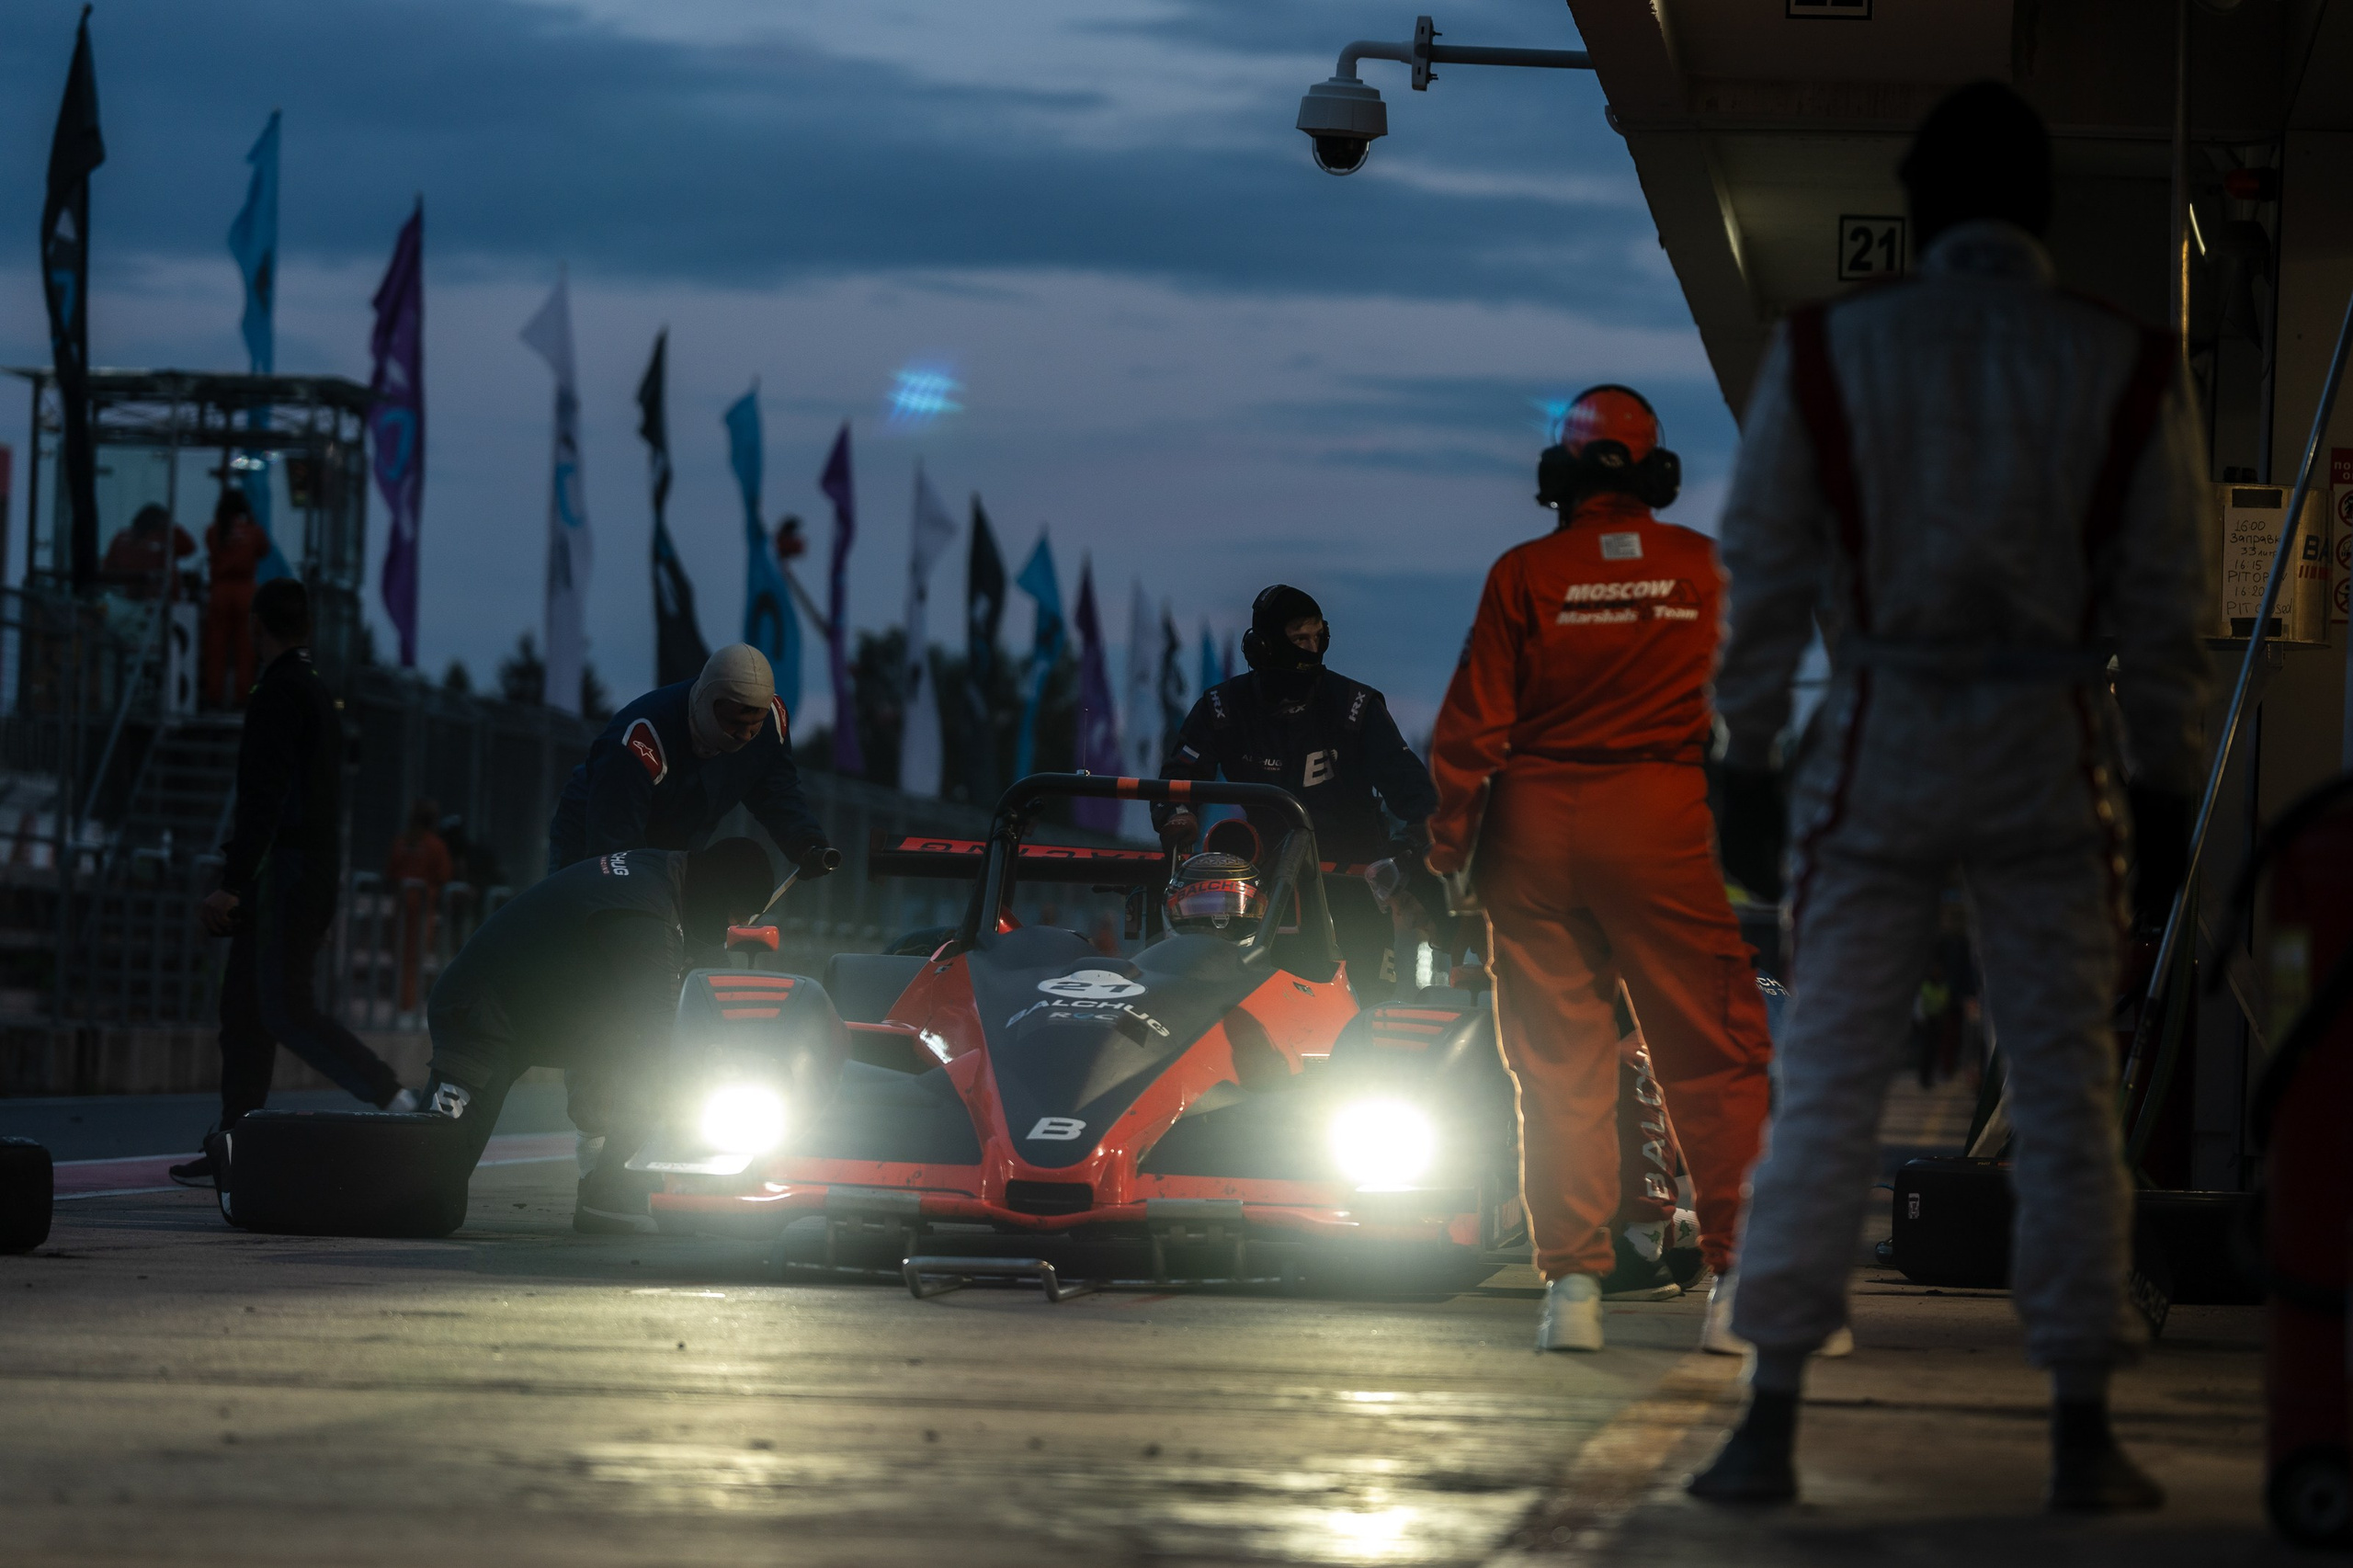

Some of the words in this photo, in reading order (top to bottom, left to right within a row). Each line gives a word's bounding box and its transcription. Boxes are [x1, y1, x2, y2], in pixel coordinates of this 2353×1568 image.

[1848, 226, 1896, 271] 21
[2234, 519, 2266, 531] 16:00
[2230, 533, 2280, 549] Заправк
[2241, 547, 2256, 556] 33
[2228, 571, 2251, 583] PIT
[1563, 578, 1677, 604] MOSCOW
[1556, 608, 1640, 626] Marshals
[1653, 604, 1699, 622] Team
[2227, 601, 2251, 615] PIT
[1210, 690, 1226, 719] HRX
[1348, 691, 1366, 722] HRX
[610, 850, 632, 876] CHUG
[1050, 981, 1131, 994] 21
[1005, 999, 1170, 1038] BALCHUG
[1025, 1117, 1087, 1141] B
